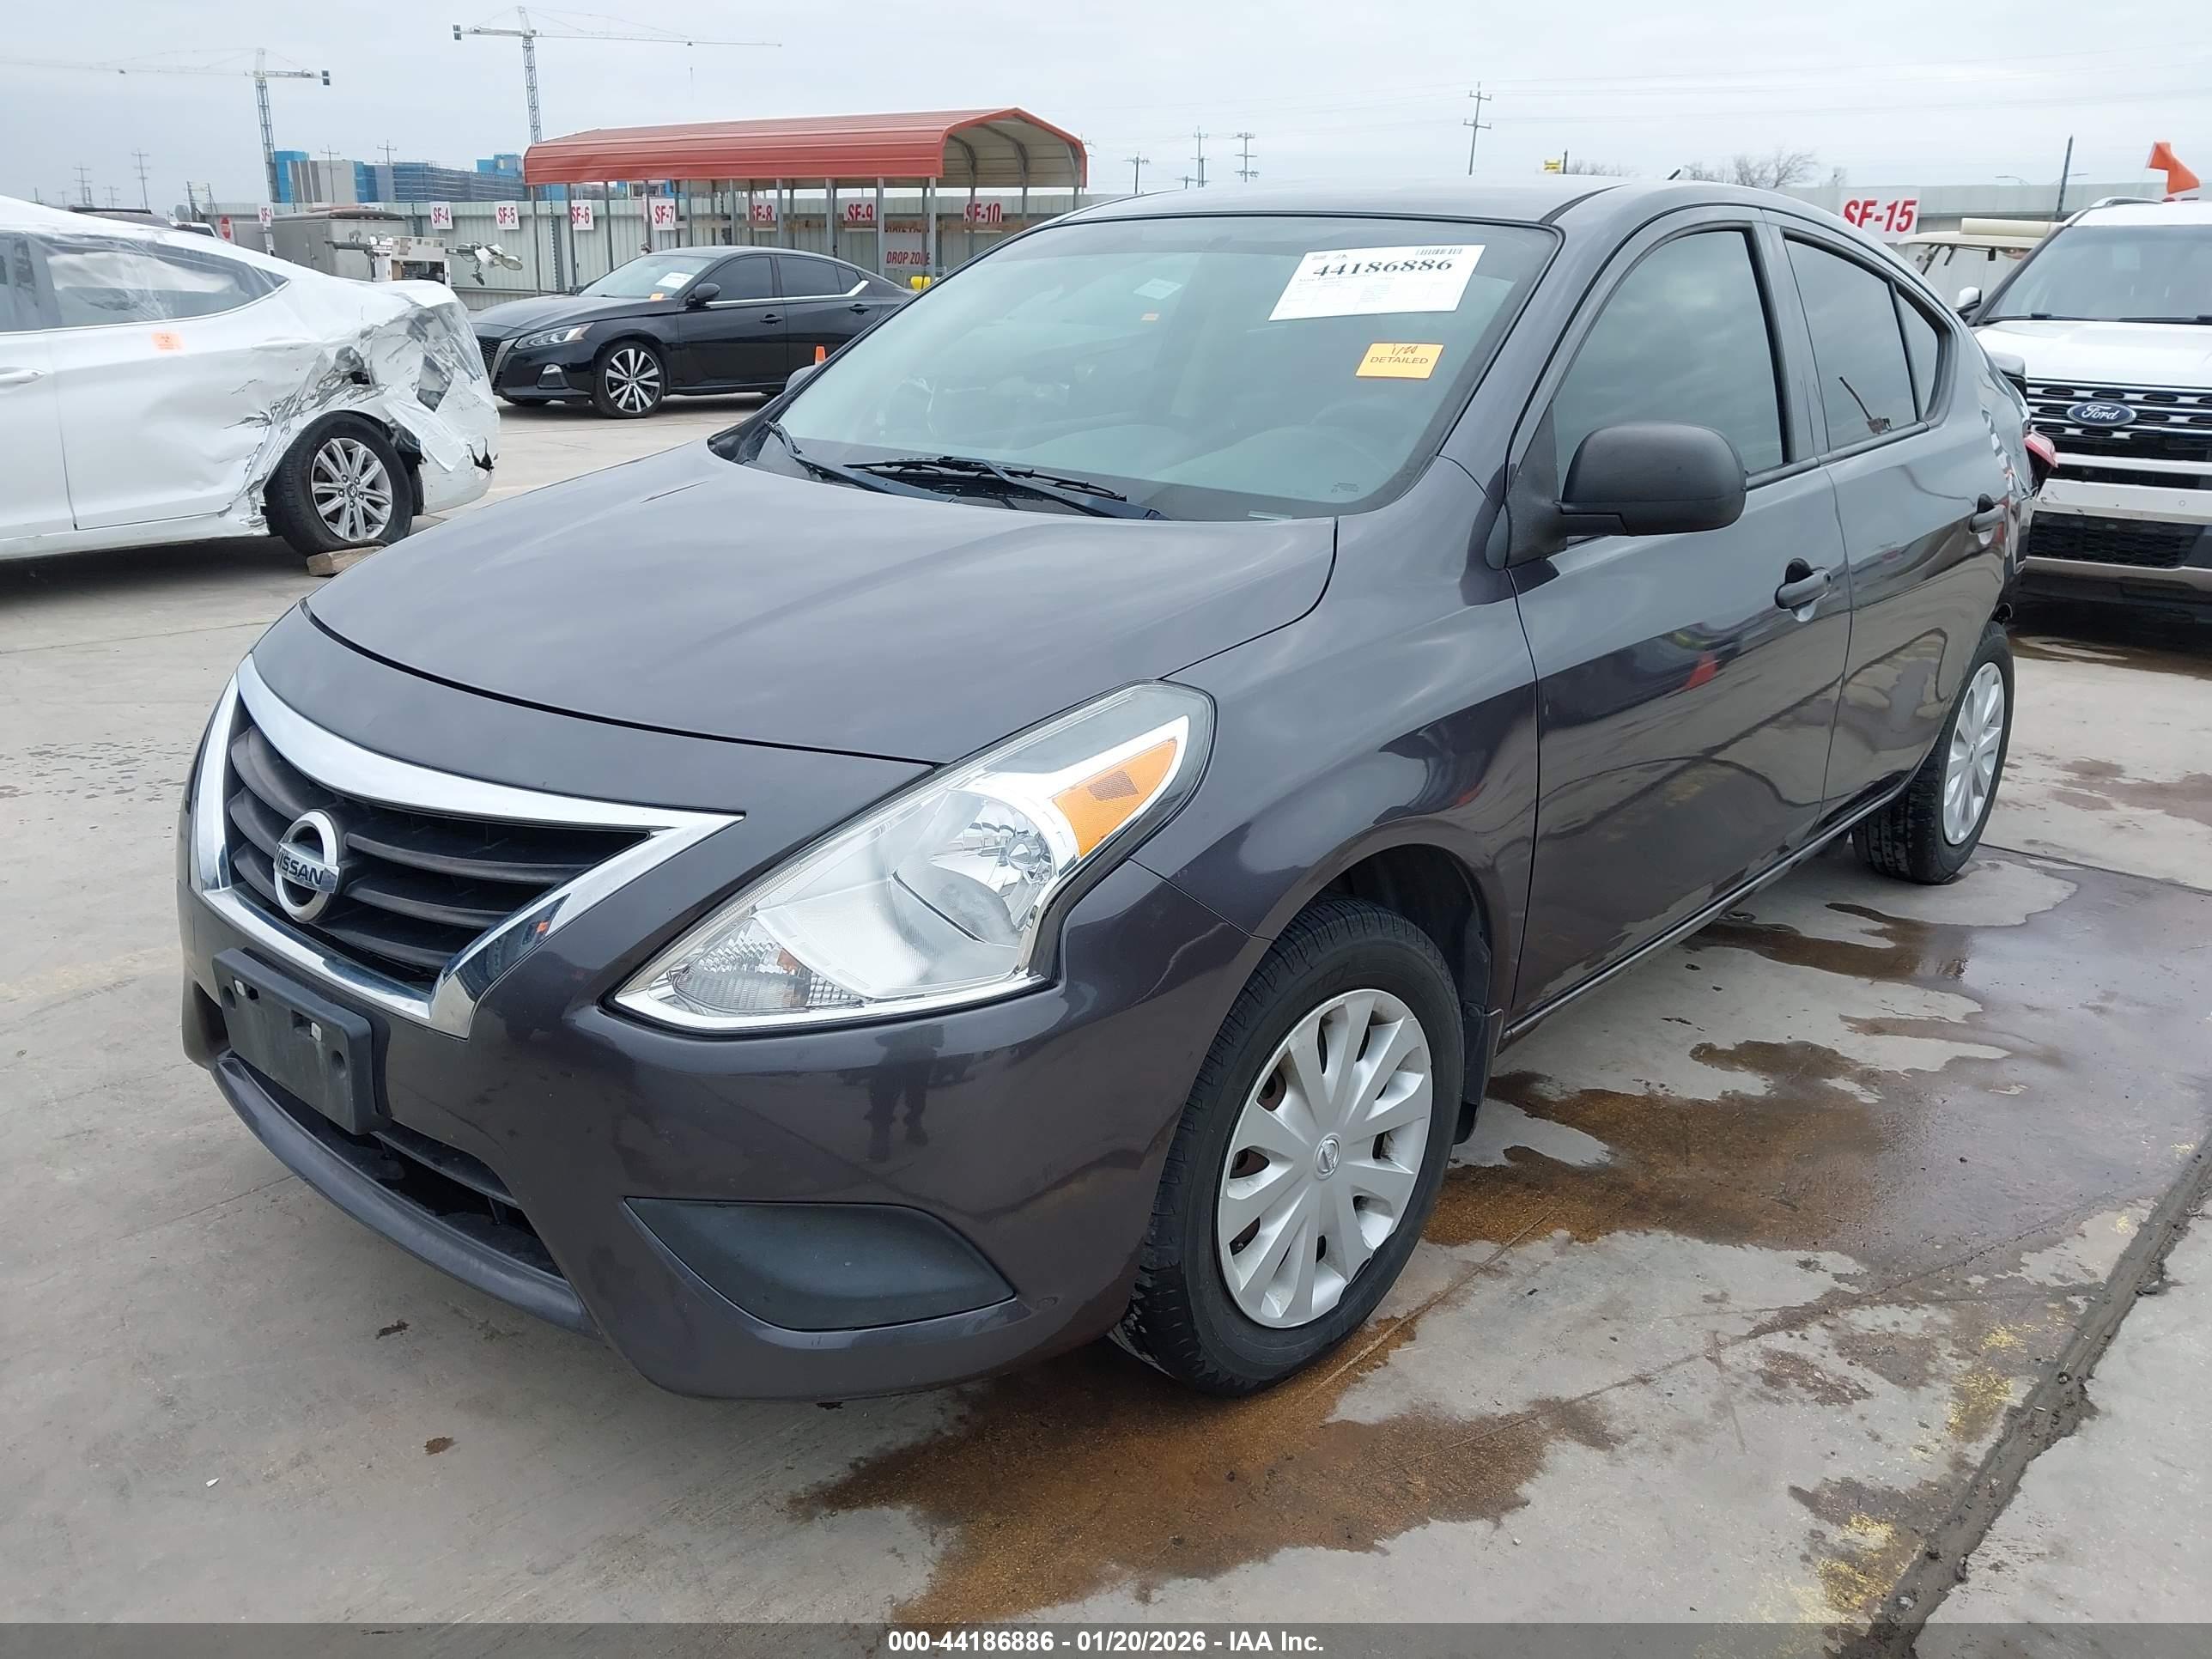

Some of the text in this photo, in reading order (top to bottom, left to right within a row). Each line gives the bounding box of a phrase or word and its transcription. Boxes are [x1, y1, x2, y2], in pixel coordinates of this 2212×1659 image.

[433, 207, 449, 223] SF-4
[498, 207, 515, 223] SF-5
[571, 206, 590, 224] SF-6
[654, 205, 674, 224] SF-7
[848, 204, 873, 221] SF-9
[886, 251, 931, 265] DROP ZOE
[1313, 258, 1454, 276] 44186886
[2081, 404, 2121, 420] Ford
[275, 846, 324, 885] NISSAN
